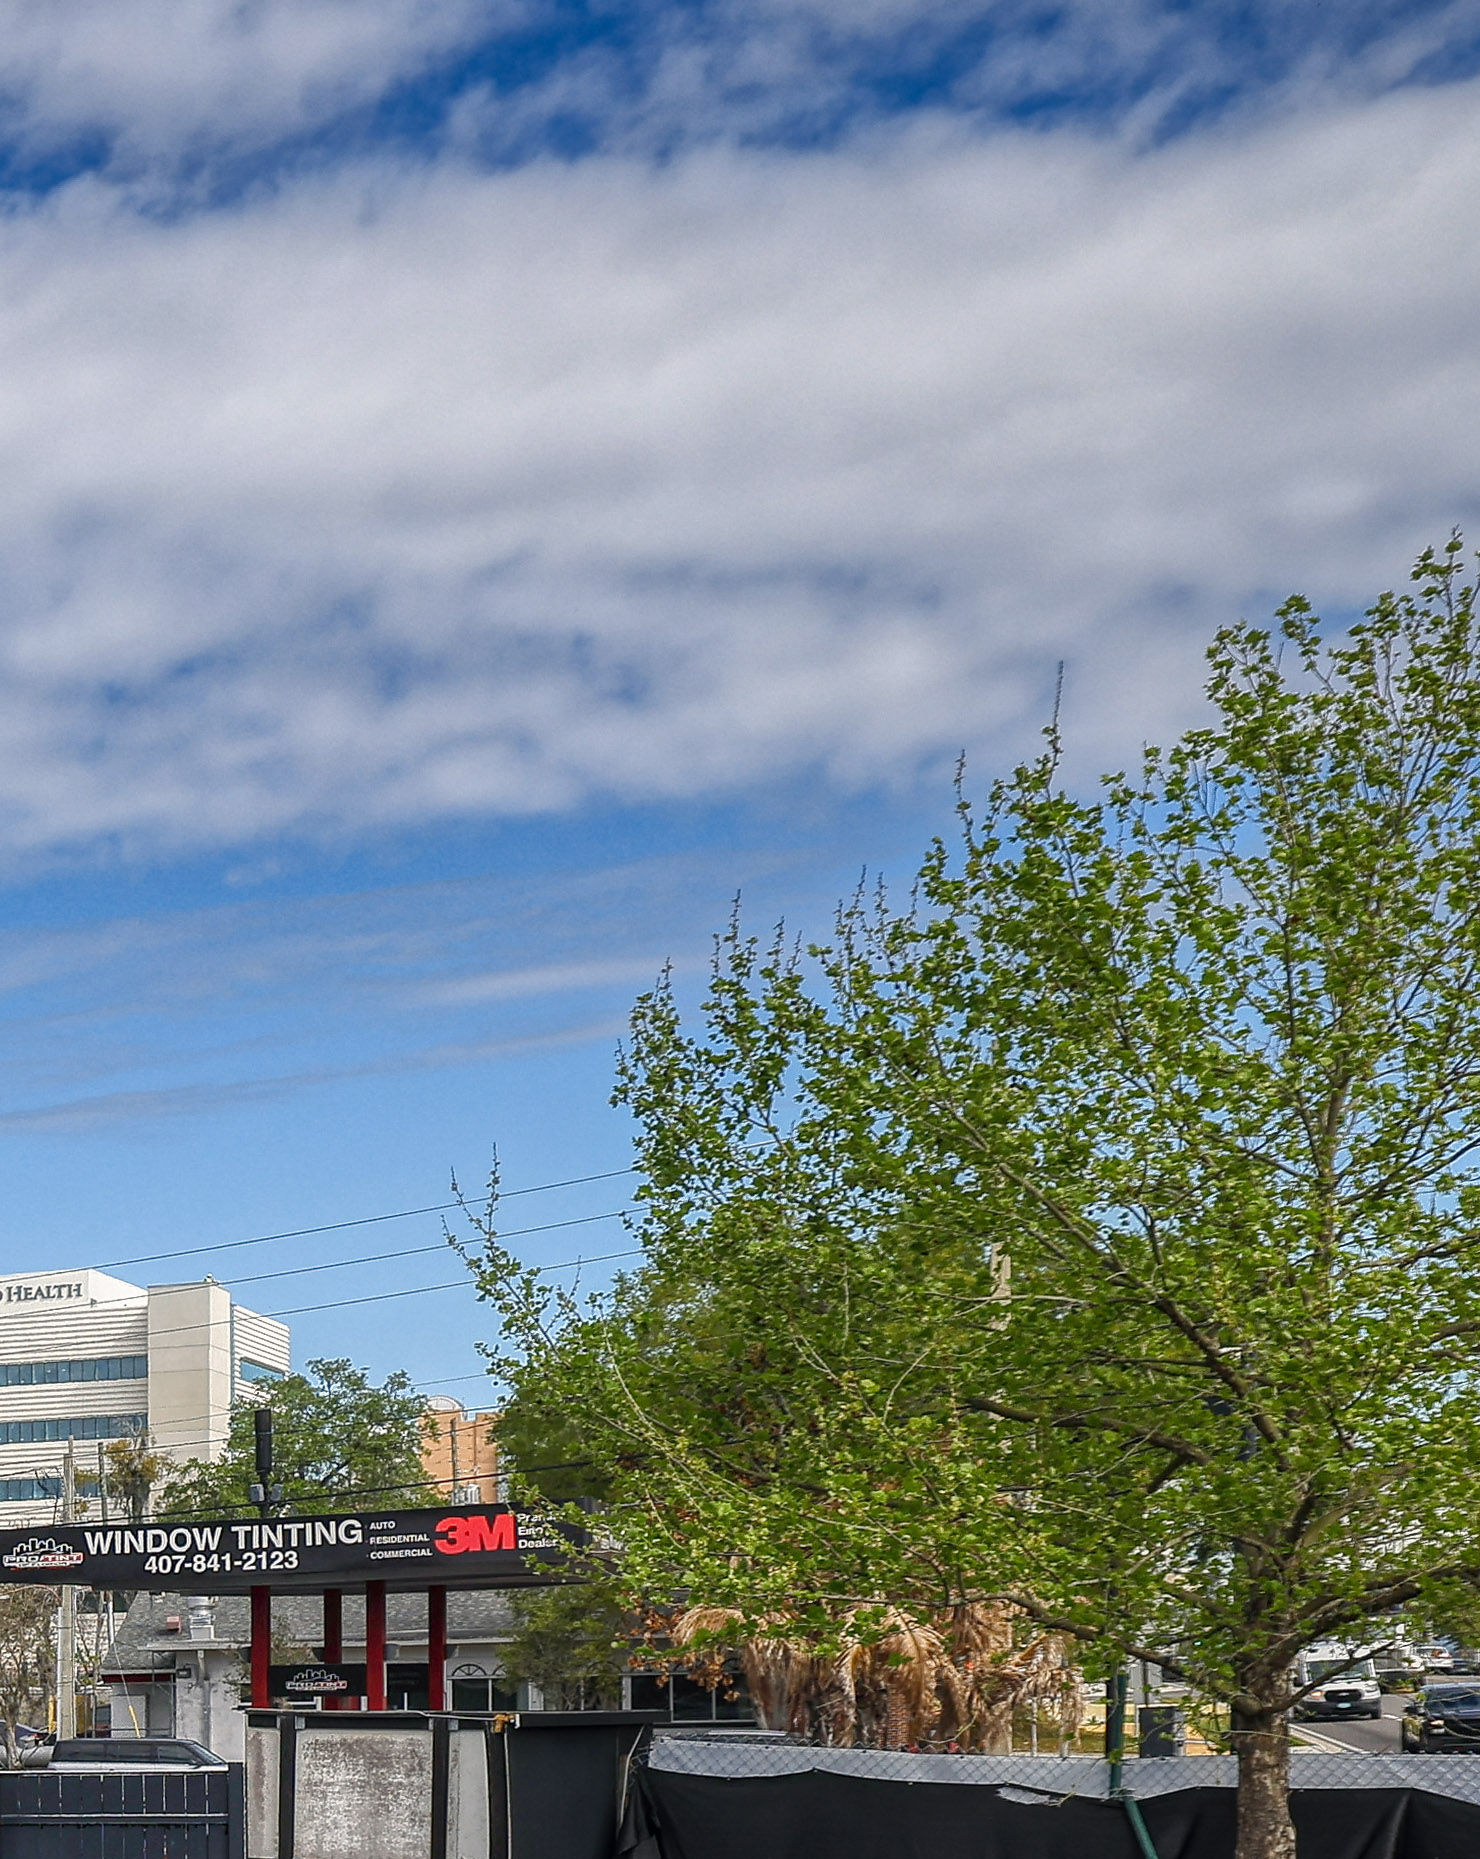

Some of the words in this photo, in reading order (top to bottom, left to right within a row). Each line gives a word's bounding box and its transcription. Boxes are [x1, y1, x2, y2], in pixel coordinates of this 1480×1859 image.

[7, 1283, 82, 1302] HEALTH
[369, 1520, 395, 1530] AUTO
[84, 1526, 222, 1555] WINDOW
[231, 1518, 363, 1549] TINTING
[369, 1533, 430, 1545] RESIDENTIAL
[434, 1514, 515, 1554] 3M
[518, 1537, 558, 1549] Dealer
[370, 1548, 433, 1560] COMMERCIAL
[145, 1550, 299, 1574] 407-841-2123
